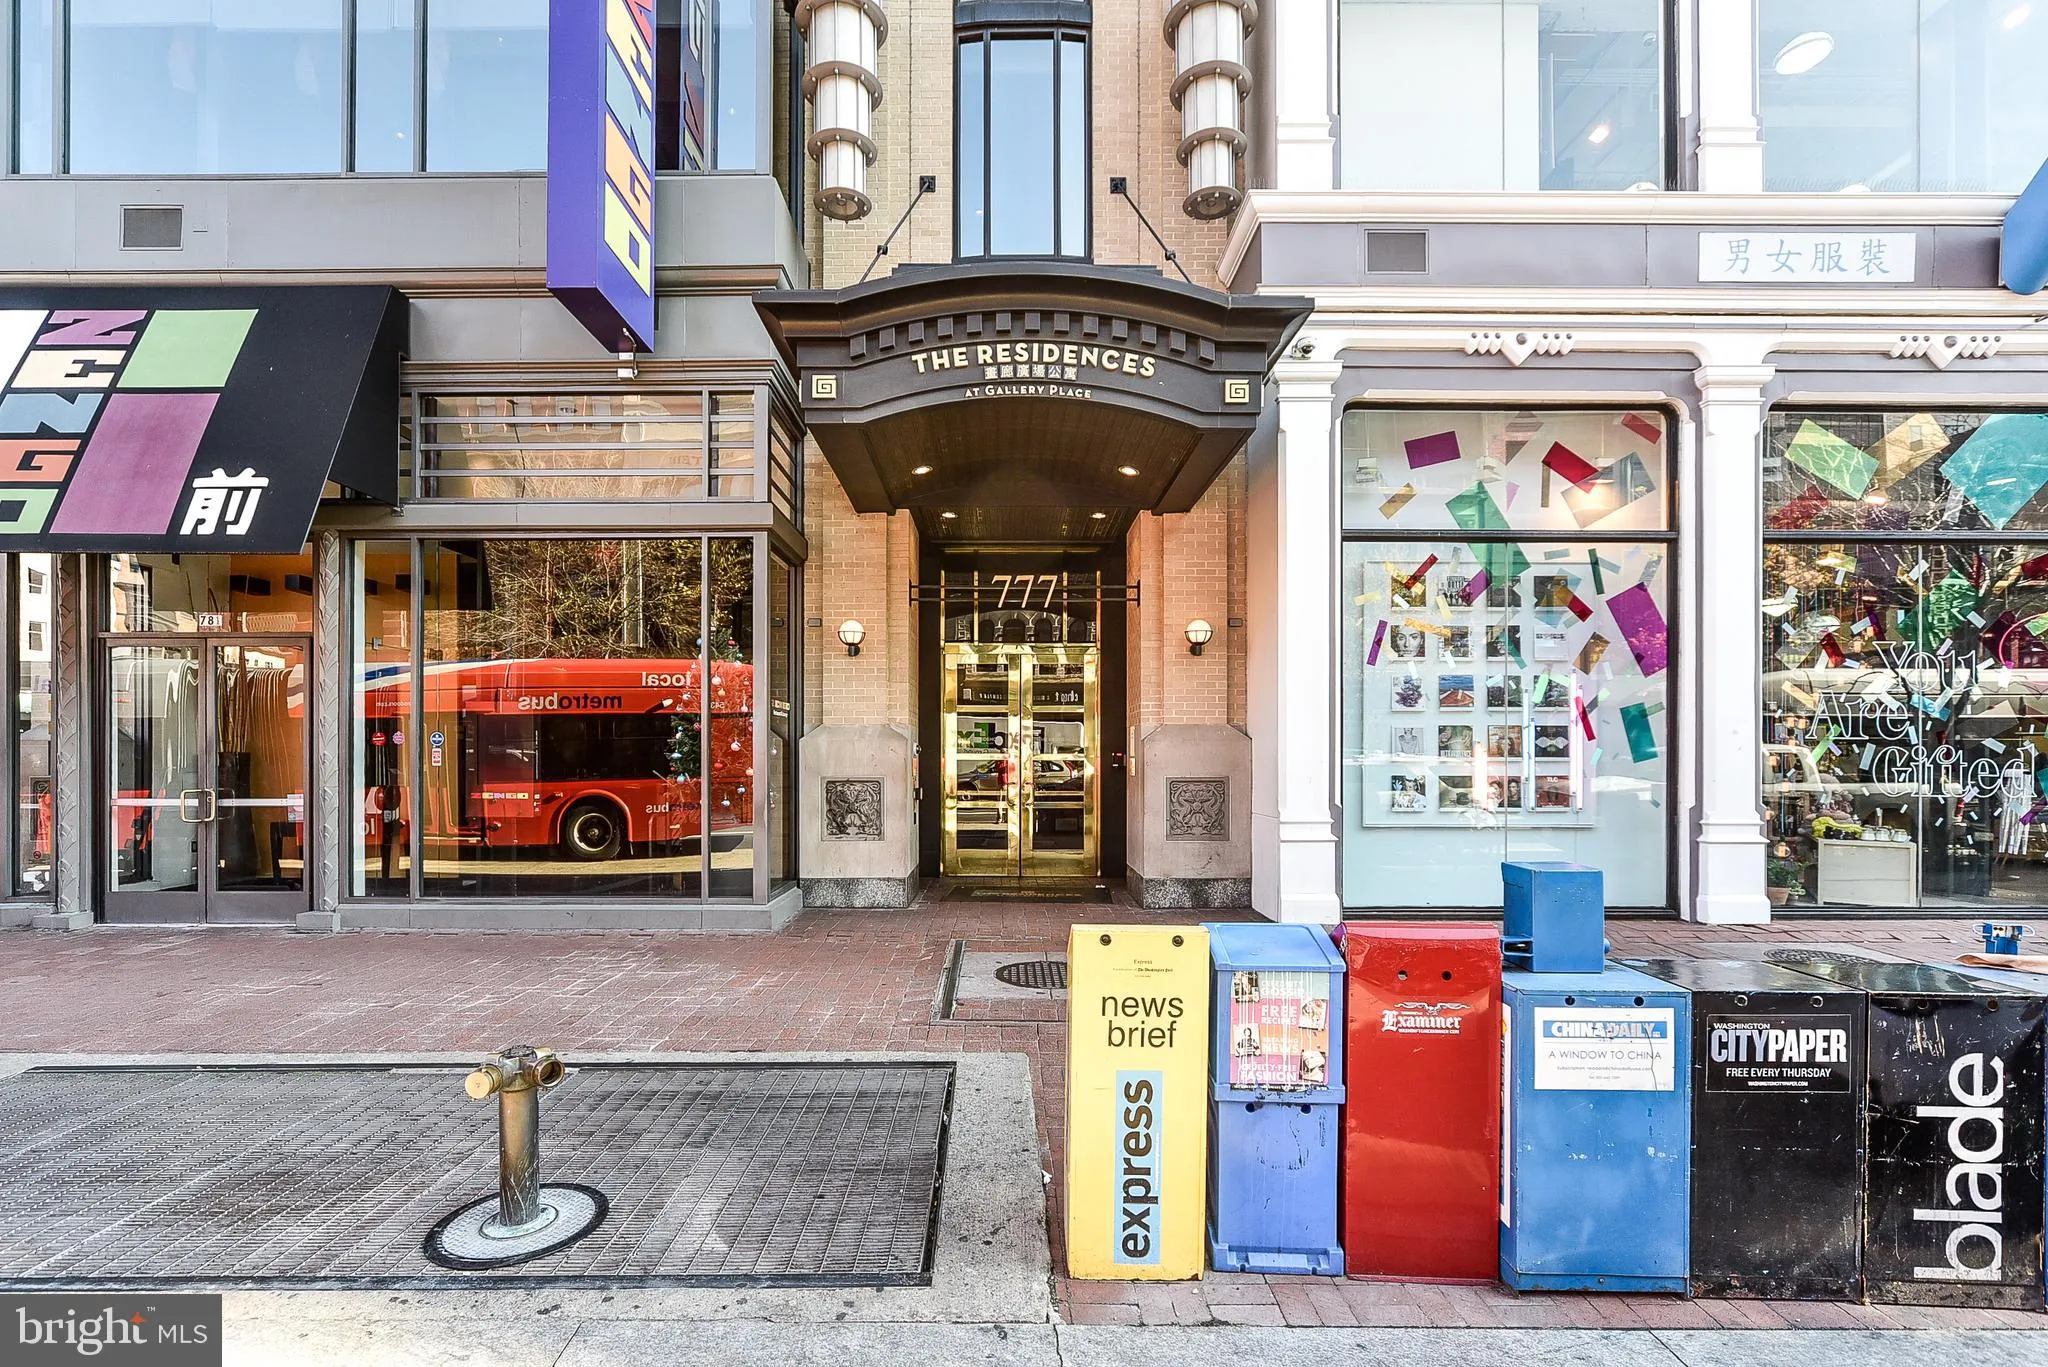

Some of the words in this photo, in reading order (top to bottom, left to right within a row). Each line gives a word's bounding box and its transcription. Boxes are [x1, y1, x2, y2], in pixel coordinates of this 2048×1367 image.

[1724, 238, 1891, 277] 男女服裝
[911, 346, 969, 375] THE
[976, 342, 1157, 378] RESIDENCES
[964, 387, 981, 398] AT
[984, 384, 1046, 397] GALLERY
[1049, 386, 1092, 399] PLACE
[179, 467, 270, 536] 前
[991, 574, 1059, 609] 777
[200, 615, 220, 626] 781
[1872, 640, 1977, 692] You
[1805, 690, 1911, 741] Are
[1872, 744, 2038, 798] Gifted
[1101, 995, 1185, 1019] news
[1261, 1005, 1298, 1018] FREE
[1381, 1010, 1463, 1033] Examiner
[1107, 1019, 1178, 1049] brief
[1713, 1022, 1770, 1030] WASHINGTON
[1549, 1051, 1556, 1060] A
[1560, 1050, 1608, 1061] WINDOW
[1611, 1050, 1625, 1061] TO
[1627, 1050, 1662, 1061] CHINA
[1726, 1067, 1749, 1078] FREE
[1750, 1067, 1781, 1078] EVERY
[1781, 1067, 1832, 1078] THURSDAY
[1121, 1078, 1160, 1259] express
[1912, 1052, 2005, 1281] blade
